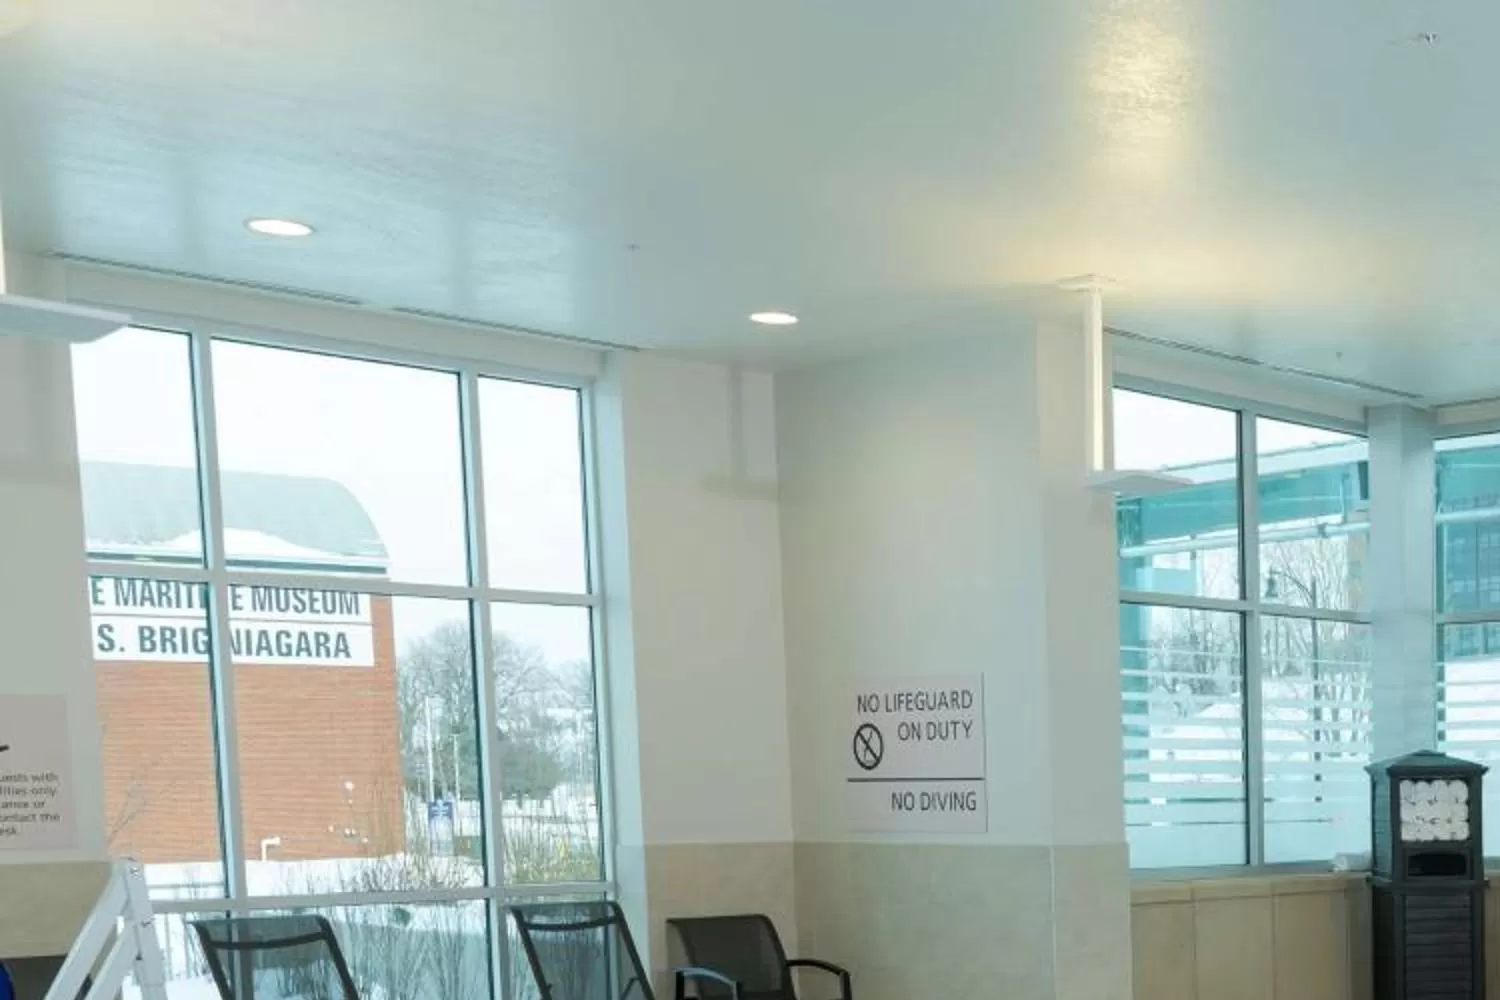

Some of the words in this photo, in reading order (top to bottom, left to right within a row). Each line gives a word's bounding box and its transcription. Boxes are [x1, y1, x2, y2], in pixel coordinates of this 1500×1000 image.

[114, 579, 244, 611] MARITIE
[251, 588, 361, 616] MUSEUM
[138, 625, 209, 655] BRIG
[230, 627, 353, 658] NIAGARA
[857, 693, 880, 714] NO
[884, 689, 974, 713] LIFEGUARD
[898, 720, 921, 742] ON
[926, 719, 974, 742] DUTY
[891, 791, 916, 812] NO
[920, 790, 977, 812] DIVING
